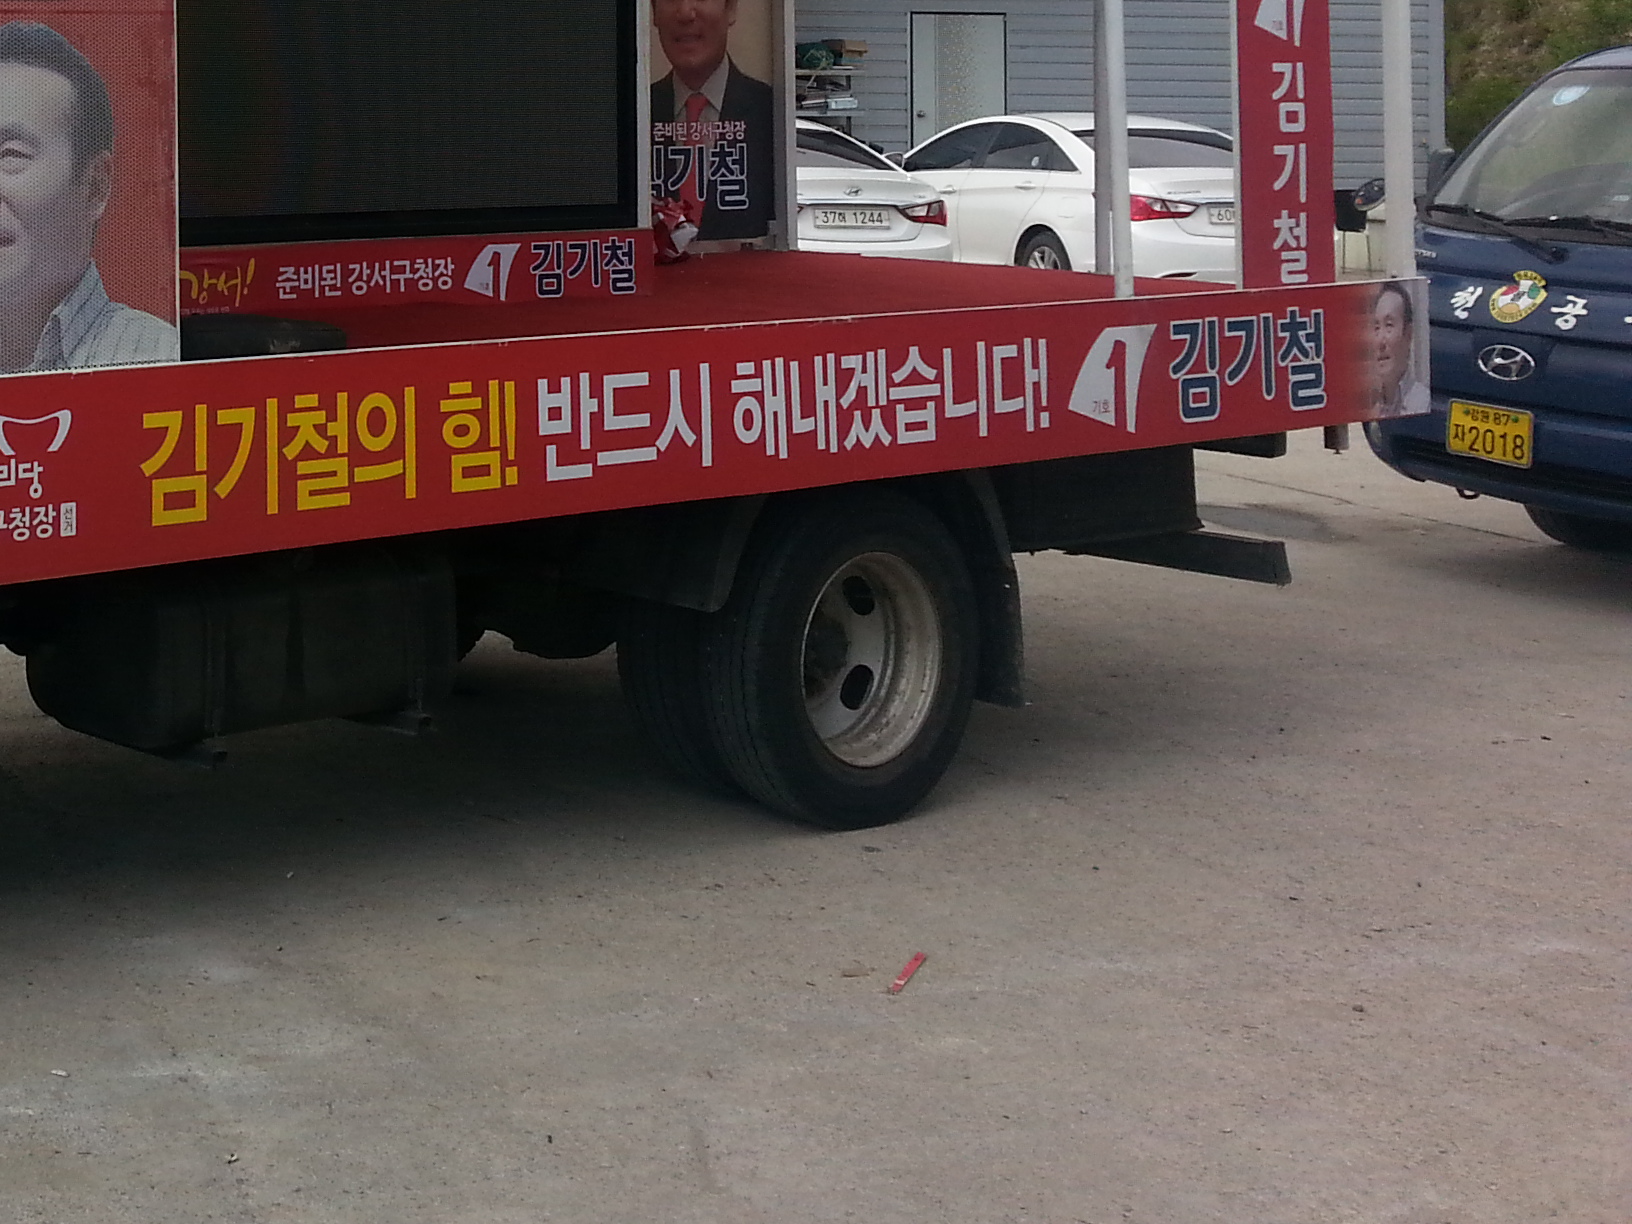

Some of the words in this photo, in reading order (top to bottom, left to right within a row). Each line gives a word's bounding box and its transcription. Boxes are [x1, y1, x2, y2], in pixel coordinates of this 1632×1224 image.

[653, 122, 687, 141] 준비된
[690, 121, 746, 140] 강서구청장
[1271, 61, 1308, 283] 김기철
[853, 211, 884, 224] 1244
[276, 263, 342, 300] 준비된
[348, 257, 455, 295] 강서구청장
[530, 236, 639, 298] 김기철
[1169, 306, 1327, 423] 김기철
[1092, 399, 1111, 414] 기호
[1471, 408, 1490, 424] 강원
[1493, 412, 1510, 426] 87
[140, 386, 417, 527] 김기철의
[439, 379, 519, 494] 힘!
[537, 361, 714, 483] 반드시
[730, 336, 1053, 462] 해내겠습니다!
